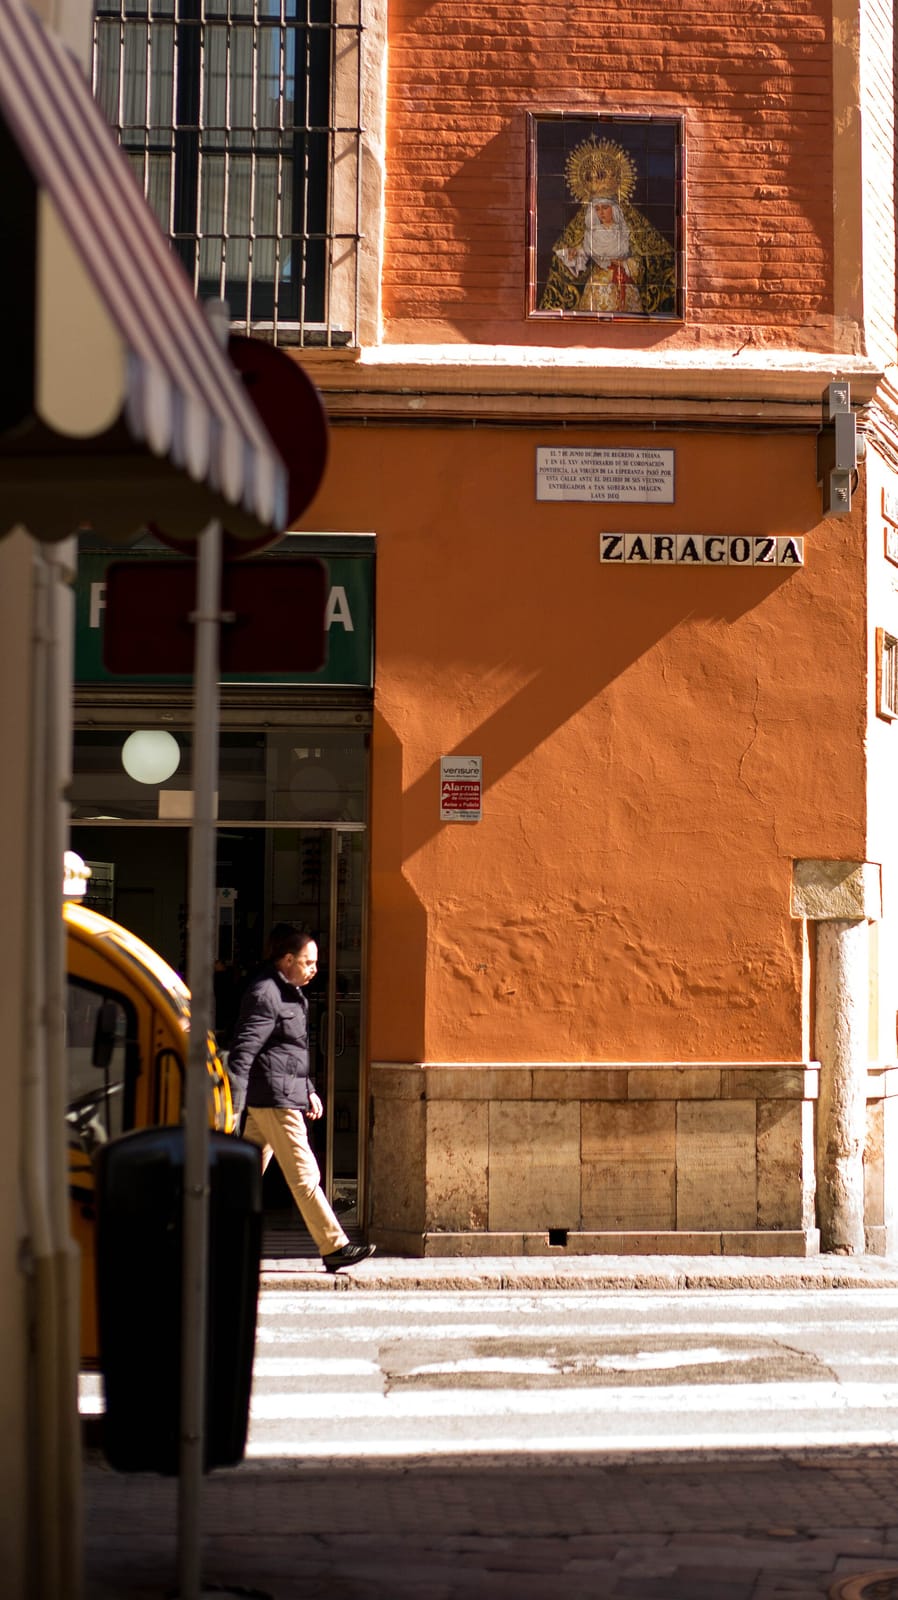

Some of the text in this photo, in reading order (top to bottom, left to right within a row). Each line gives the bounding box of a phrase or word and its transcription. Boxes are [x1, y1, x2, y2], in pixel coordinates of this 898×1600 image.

[602, 535, 803, 563] ZARAGOZA
[443, 767, 480, 775] verisure
[443, 783, 480, 791] Alarma
